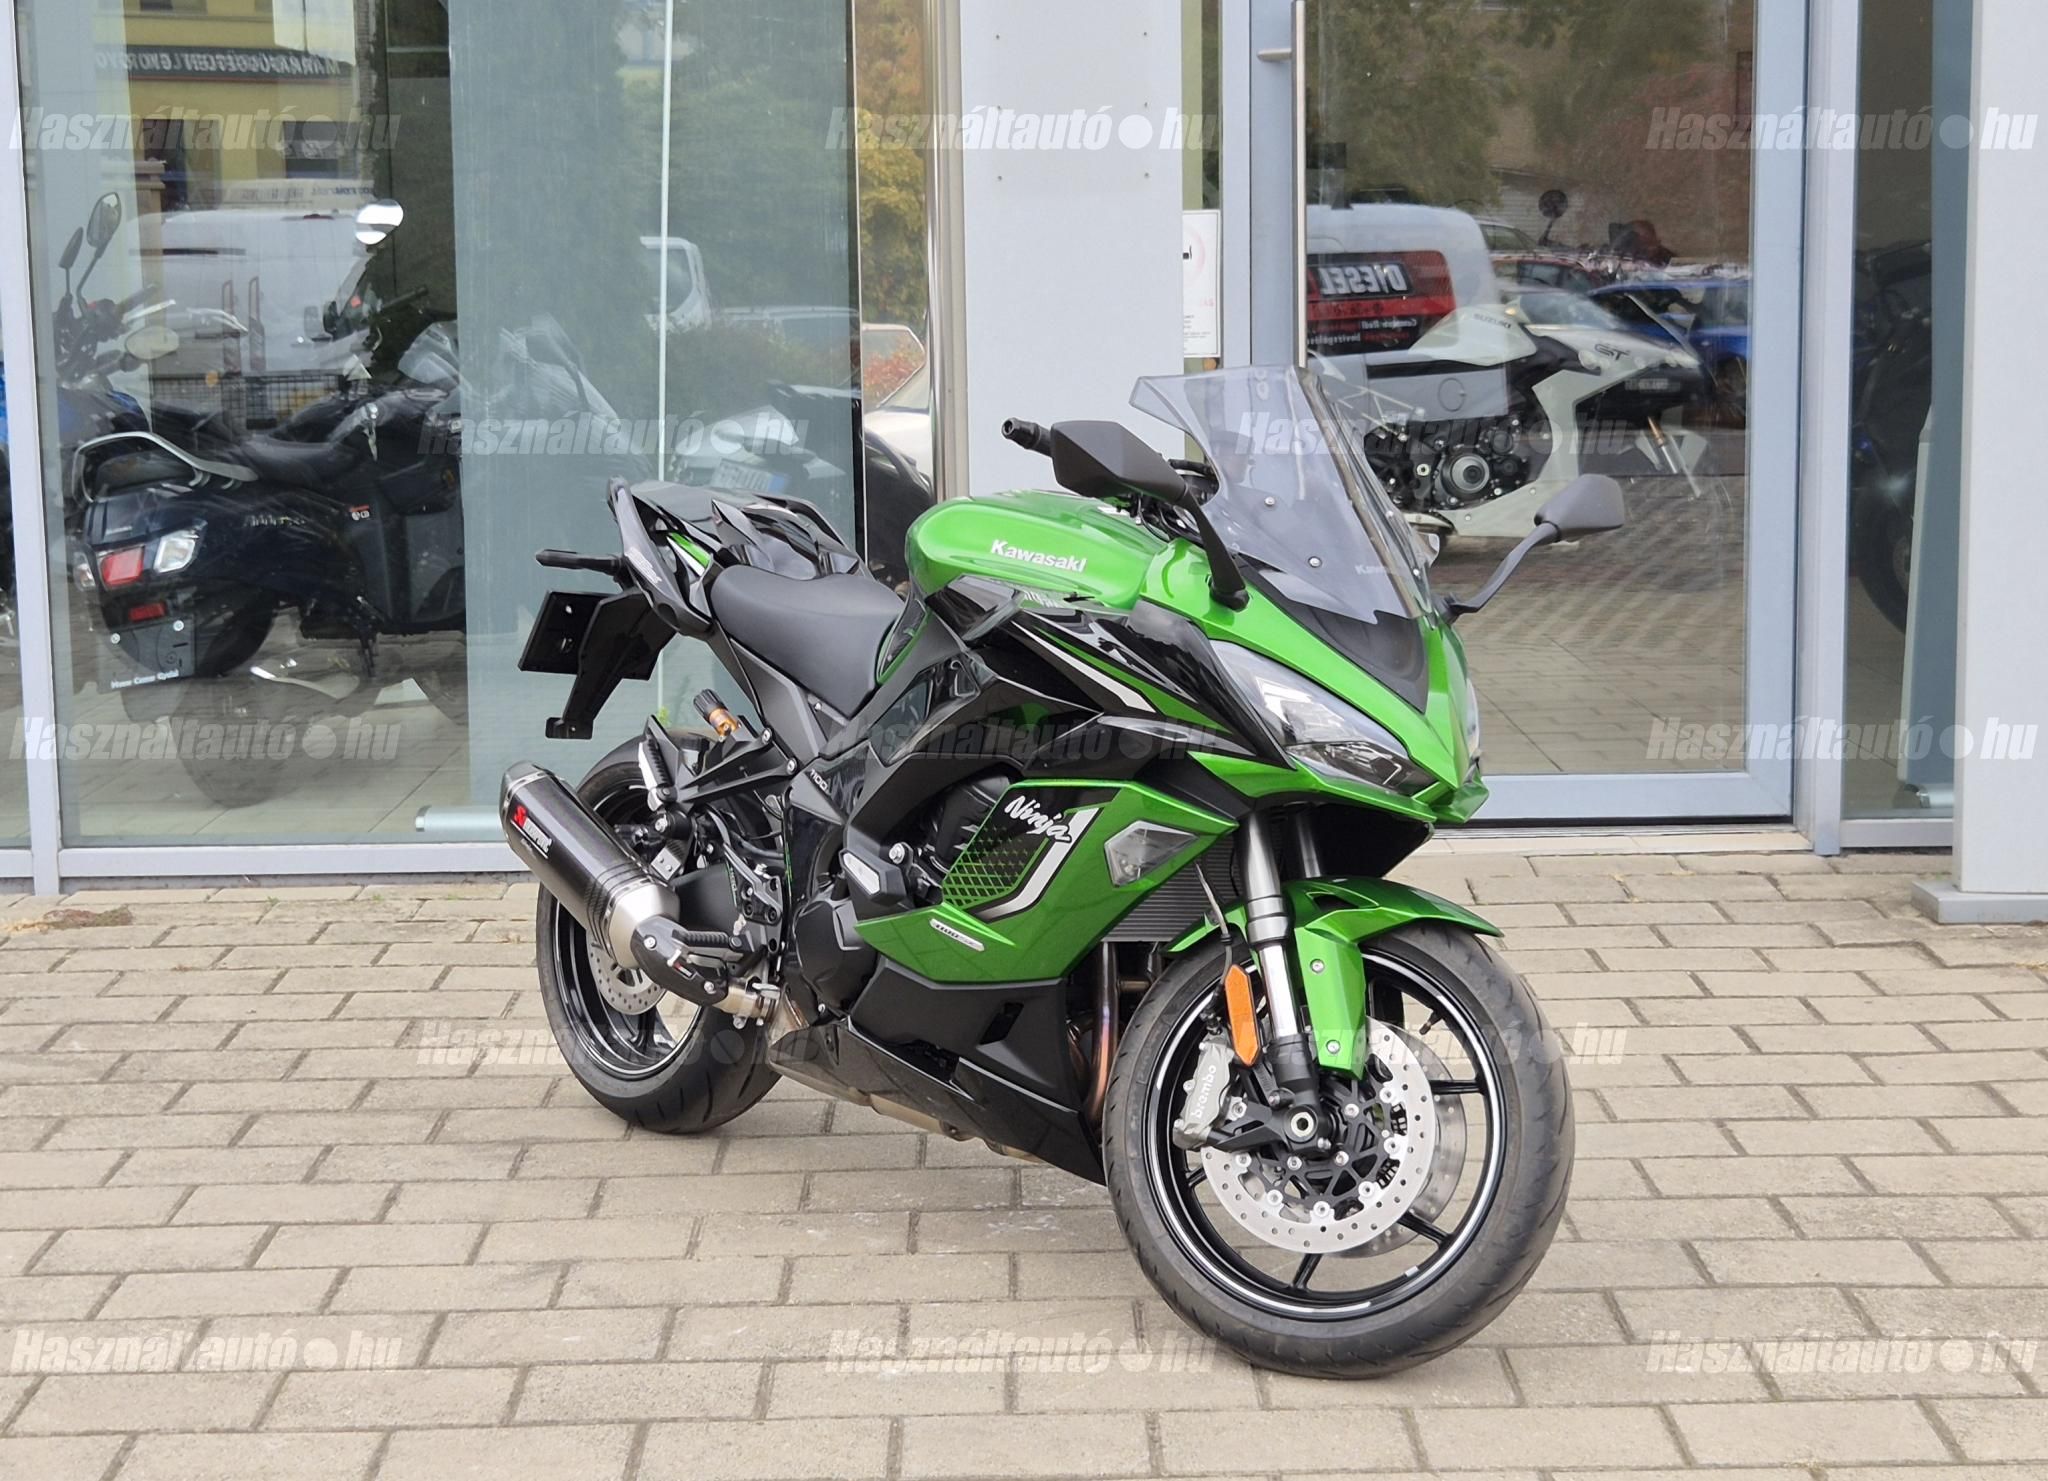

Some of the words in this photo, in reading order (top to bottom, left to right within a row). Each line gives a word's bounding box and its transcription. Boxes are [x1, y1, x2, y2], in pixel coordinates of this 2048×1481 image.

[990, 539, 1087, 573] Kawasaki
[1004, 795, 1071, 841] Ninja
[1190, 1064, 1217, 1118] brembo
